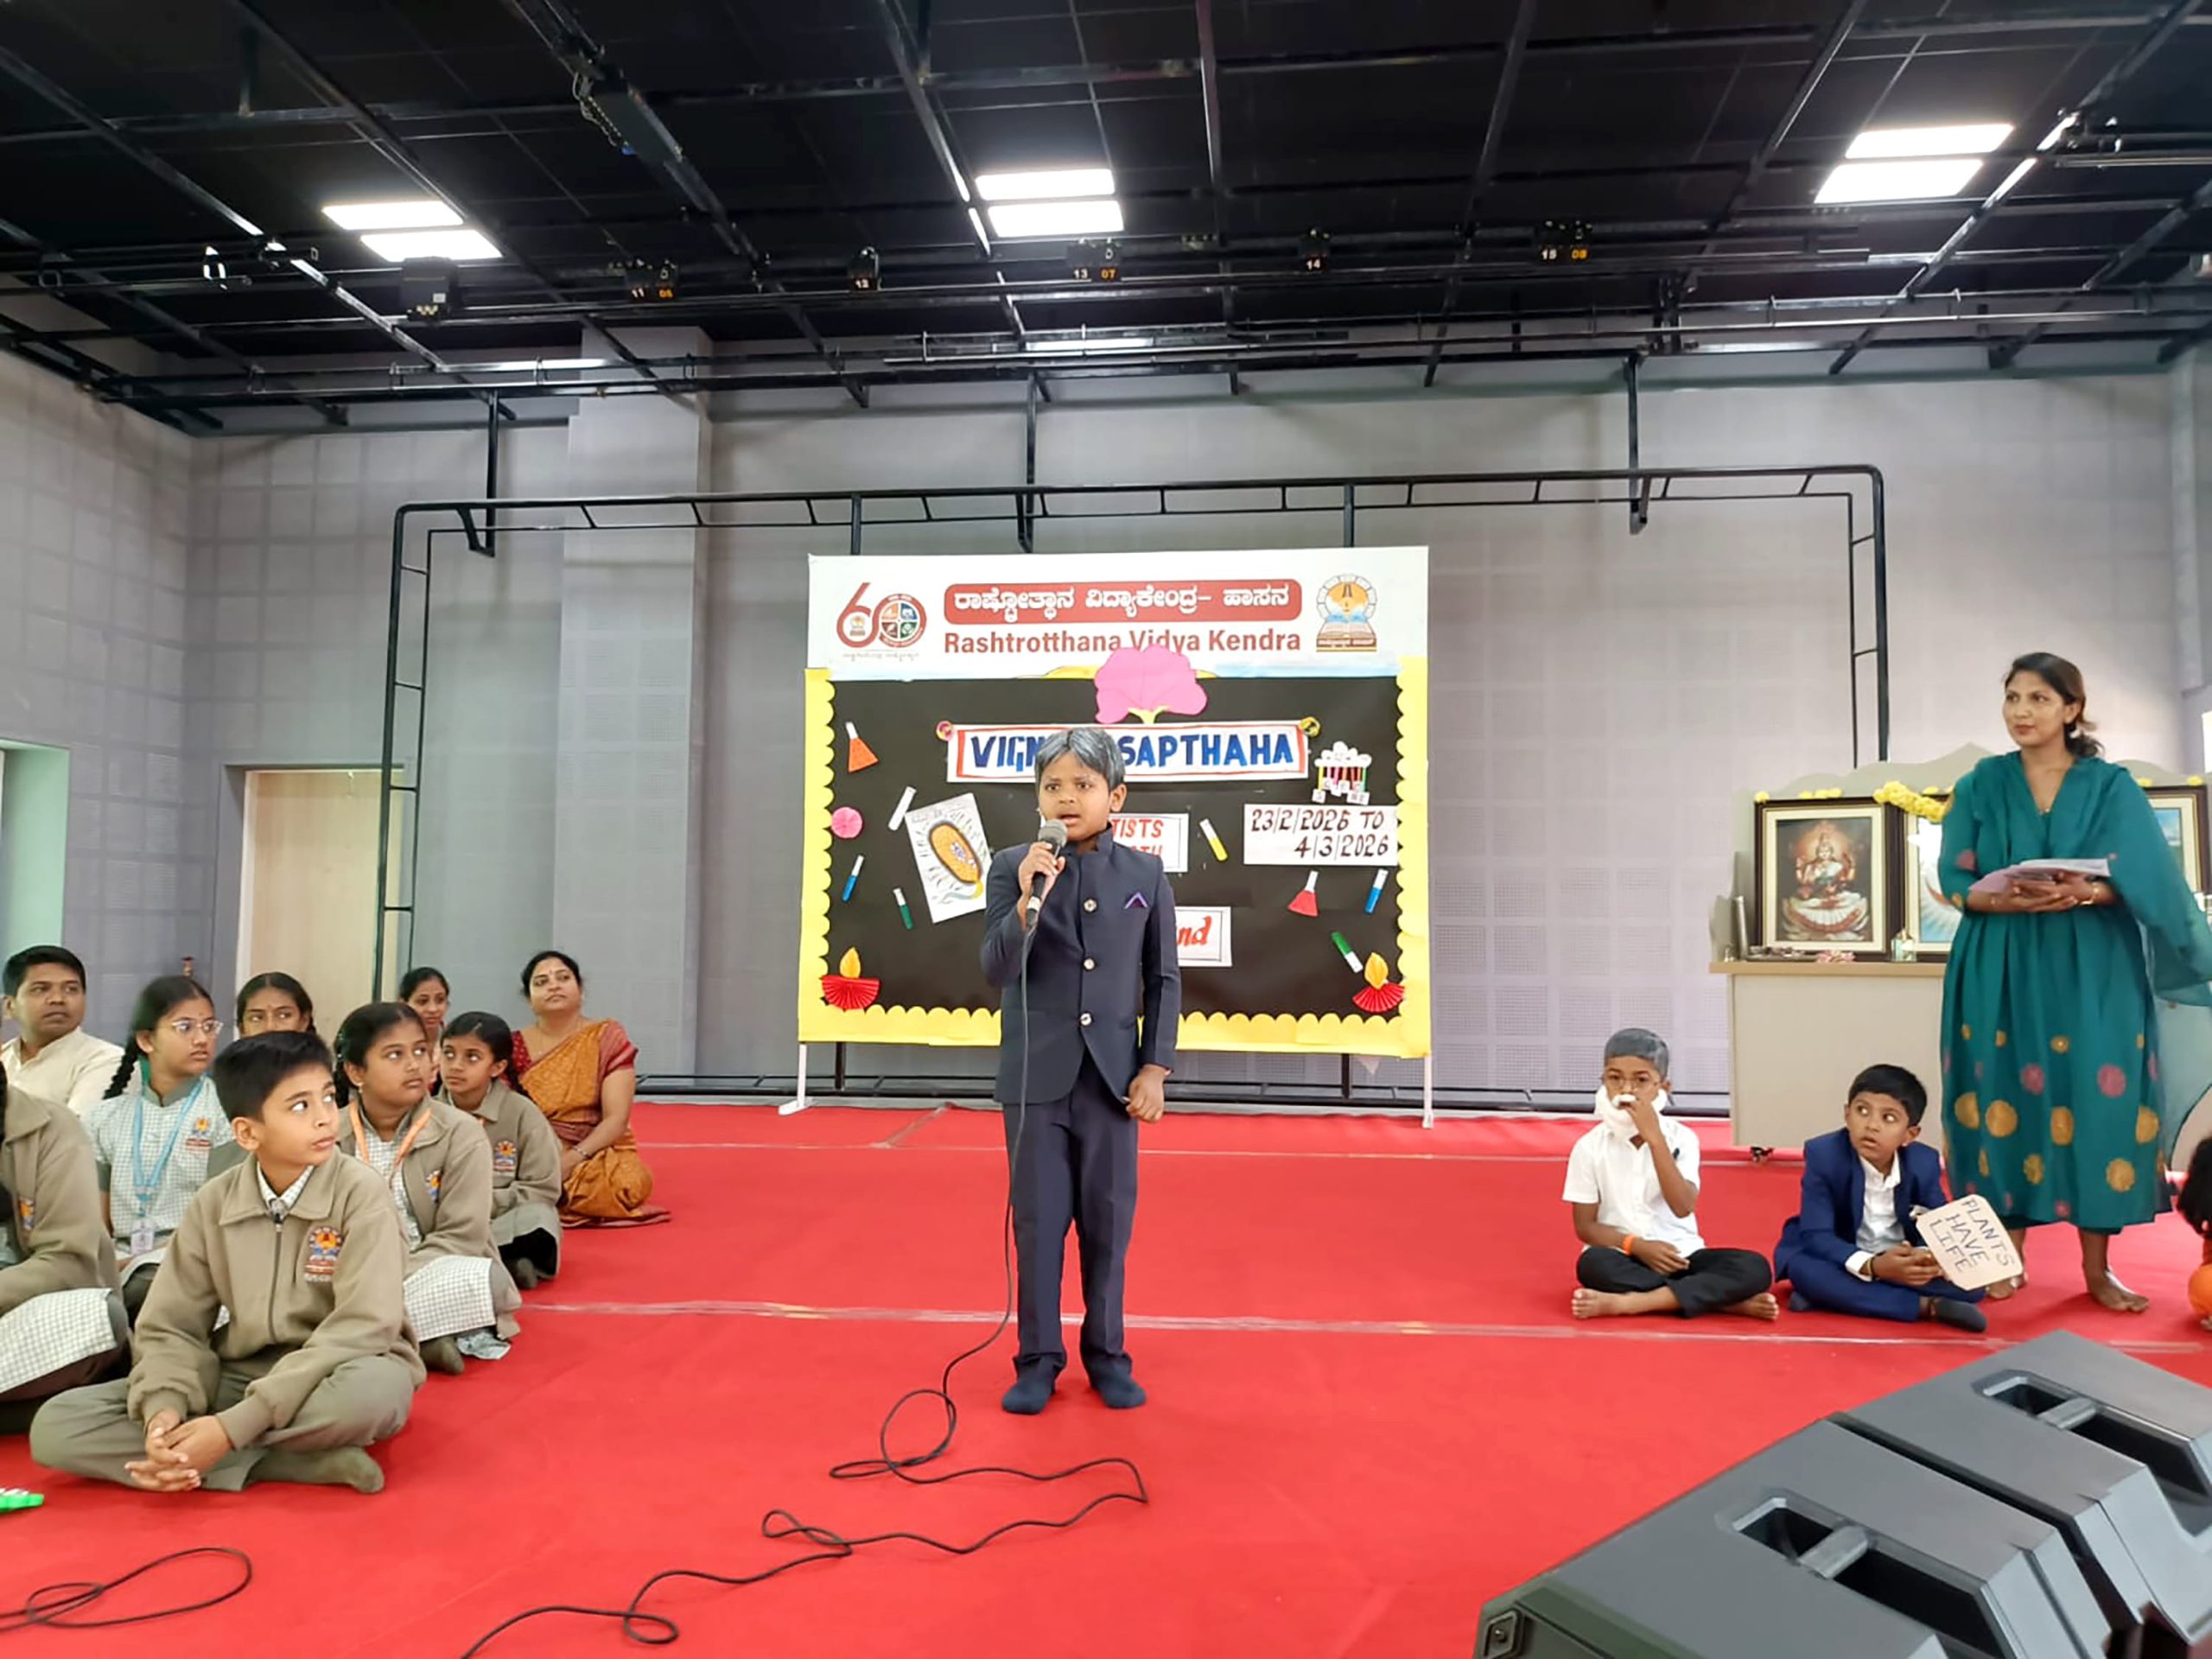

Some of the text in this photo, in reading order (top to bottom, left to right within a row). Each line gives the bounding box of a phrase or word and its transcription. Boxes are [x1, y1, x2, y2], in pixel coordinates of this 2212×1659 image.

[1223, 584, 1289, 607] ಹಾಸನ
[944, 630, 1122, 653] Rashtrotthana
[1128, 629, 1200, 656] Vidya
[1209, 628, 1300, 652] Kendra
[970, 733, 1294, 772] VIGN SAPTHAHA
[1360, 810, 1384, 830] TO
[1294, 833, 1389, 861] 4/3/2026
[1929, 1219, 1973, 1272] LIFE
[1945, 1213, 1990, 1266] HAVE
[1961, 1198, 2014, 1266] PLANTS
